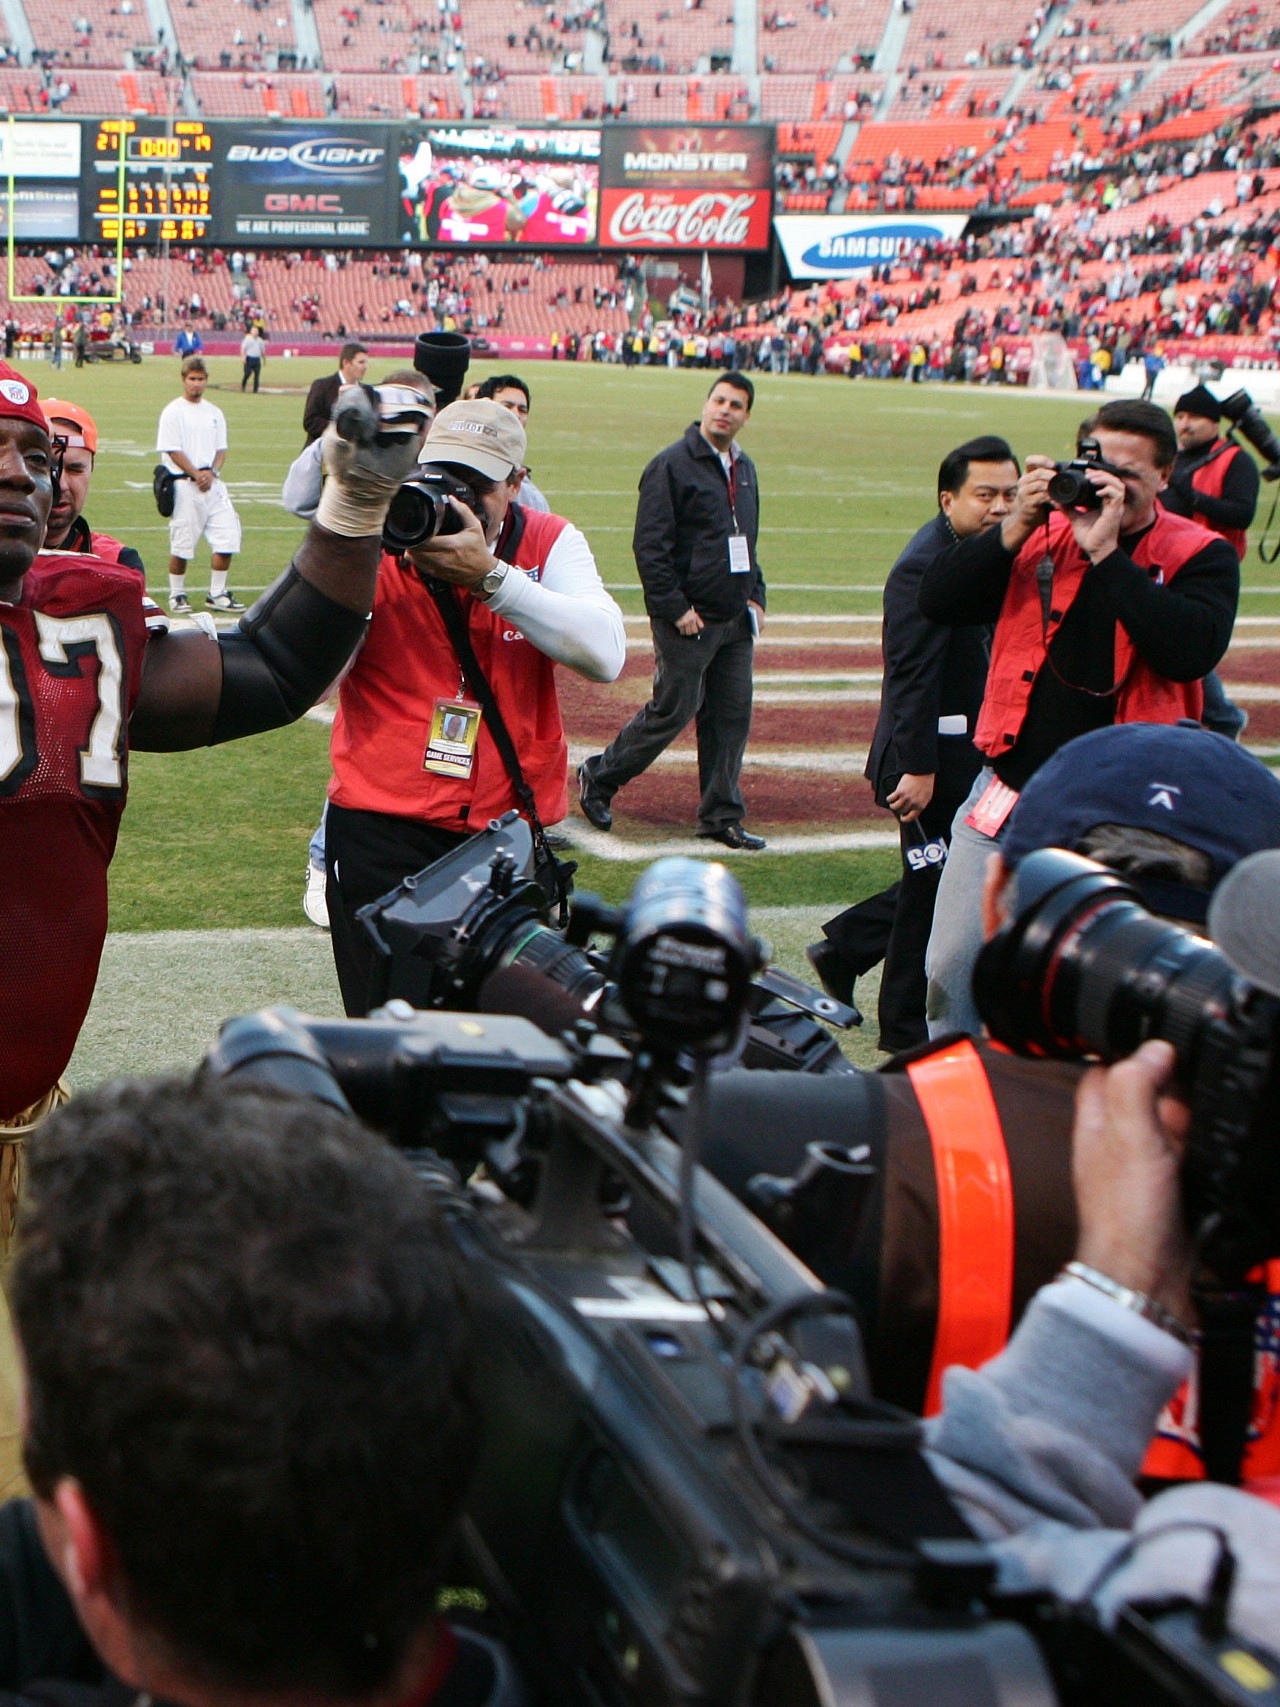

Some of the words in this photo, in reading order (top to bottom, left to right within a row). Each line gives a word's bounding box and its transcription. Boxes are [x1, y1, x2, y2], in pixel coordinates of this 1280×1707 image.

[96, 133, 118, 151] 21
[139, 137, 179, 158] 0:00
[226, 145, 290, 162] BUD
[302, 147, 385, 163] LIGHT
[623, 152, 748, 171] MONSTER
[264, 194, 341, 212] GMC
[609, 192, 757, 243] Coca-Cola
[236, 220, 251, 234] WE
[252, 221, 269, 234] ARE
[271, 221, 336, 235] PROFESSIONAL
[426, 750, 443, 761] GAME
[443, 754, 471, 766] SERVICES
